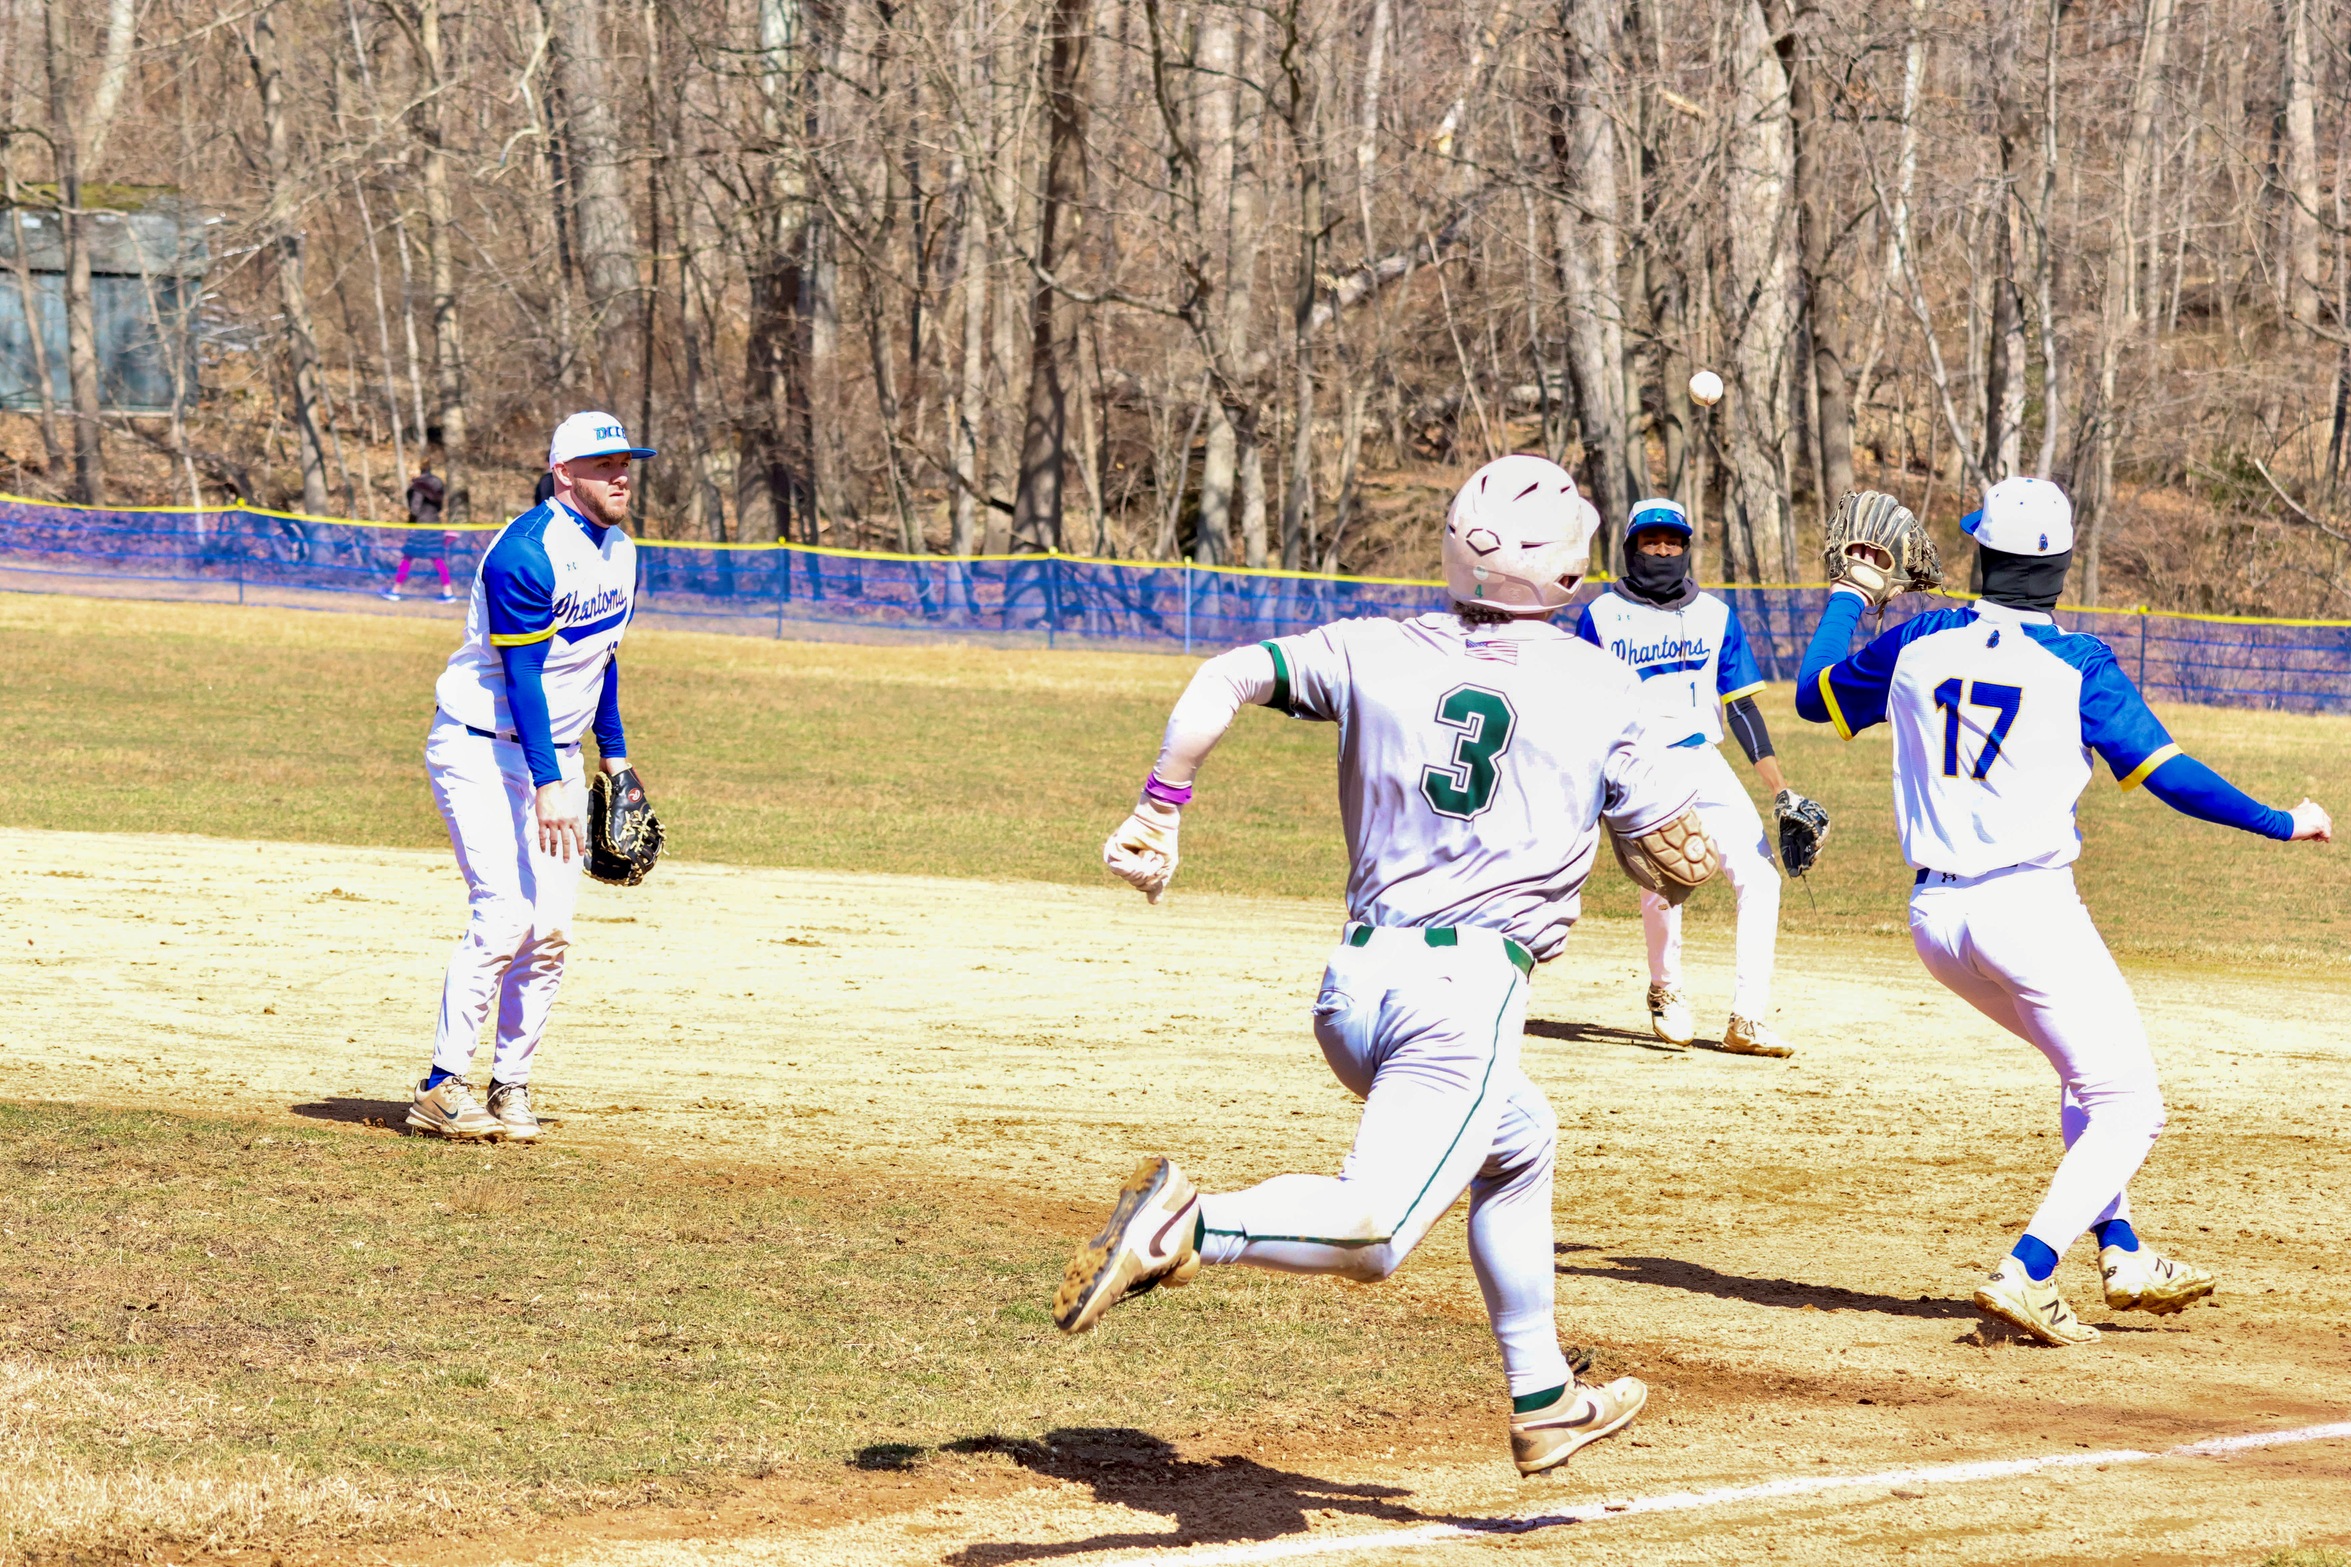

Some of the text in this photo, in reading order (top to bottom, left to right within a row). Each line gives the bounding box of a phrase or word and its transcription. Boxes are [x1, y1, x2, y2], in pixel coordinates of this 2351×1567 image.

[552, 584, 628, 624] Phantoms
[1610, 634, 1711, 666] Phantoms
[1690, 681, 1697, 708] 1
[1932, 676, 2025, 782] 17
[1419, 681, 1519, 823] 3
